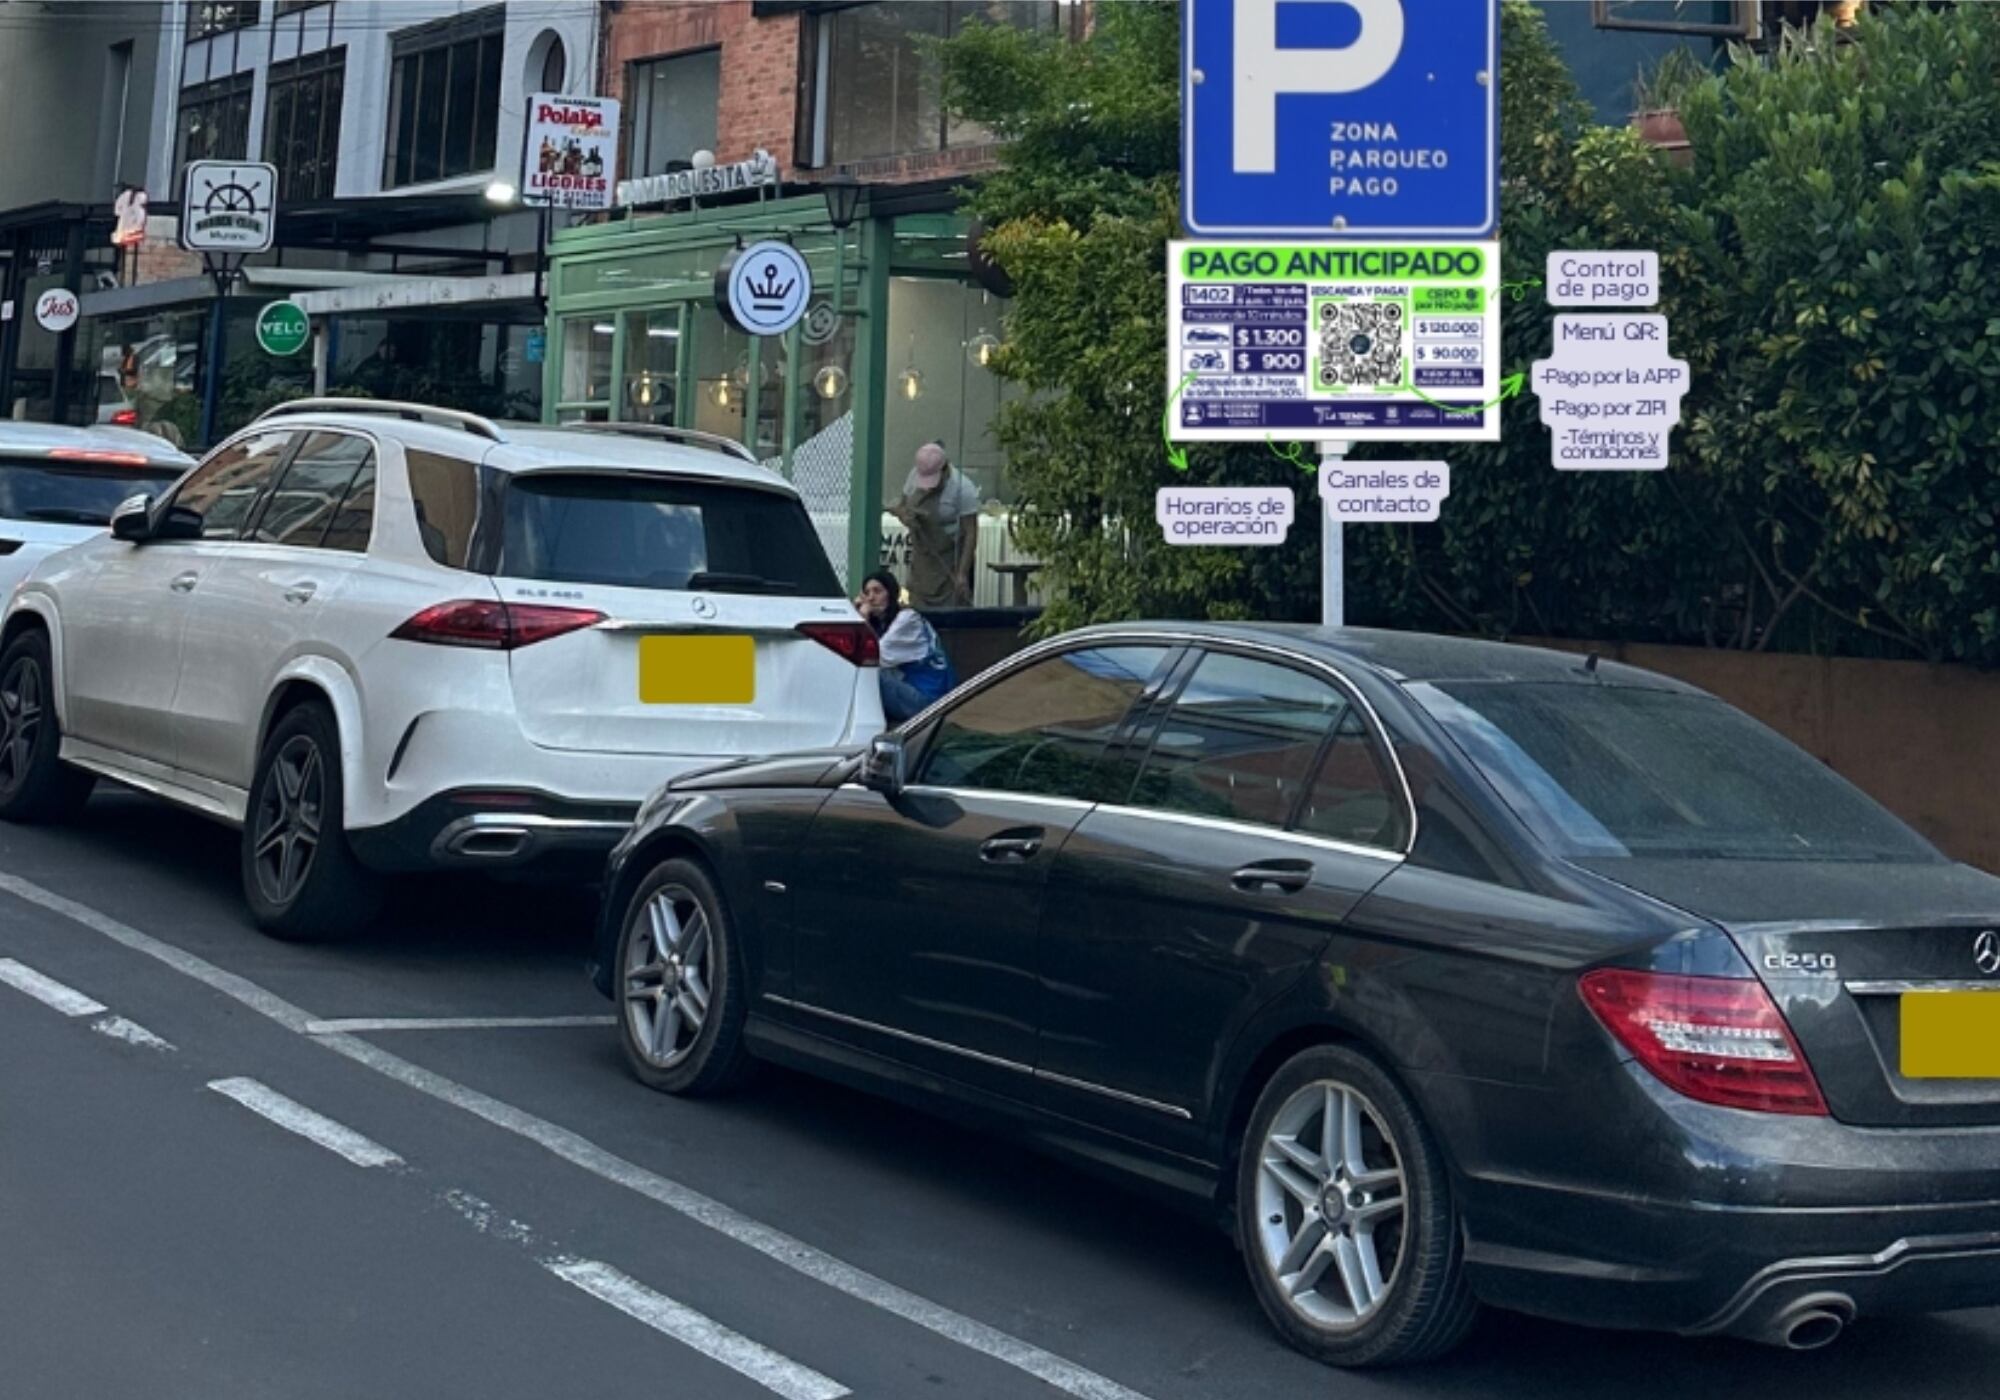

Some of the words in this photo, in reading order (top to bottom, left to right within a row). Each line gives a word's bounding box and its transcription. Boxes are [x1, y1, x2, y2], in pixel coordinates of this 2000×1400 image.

[1233, 0, 1404, 173] P
[1331, 122, 1398, 141] ZONA
[1330, 150, 1447, 169] PARQUEO
[531, 173, 606, 191] LICORES
[1330, 177, 1398, 196] PAGO
[1187, 251, 1278, 277] PAGO
[1285, 251, 1480, 277] ANTICIPADO
[1190, 287, 1230, 302] 1402
[1427, 288, 1460, 299] CEPO
[1419, 322, 1427, 333] $
[1430, 322, 1479, 333] 120.000
[1237, 328, 1249, 346] $
[1252, 329, 1302, 345] 1.300
[1237, 352, 1250, 369] $
[1262, 353, 1301, 369] 900
[1417, 347, 1425, 360] $
[1432, 347, 1479, 359] 90.000
